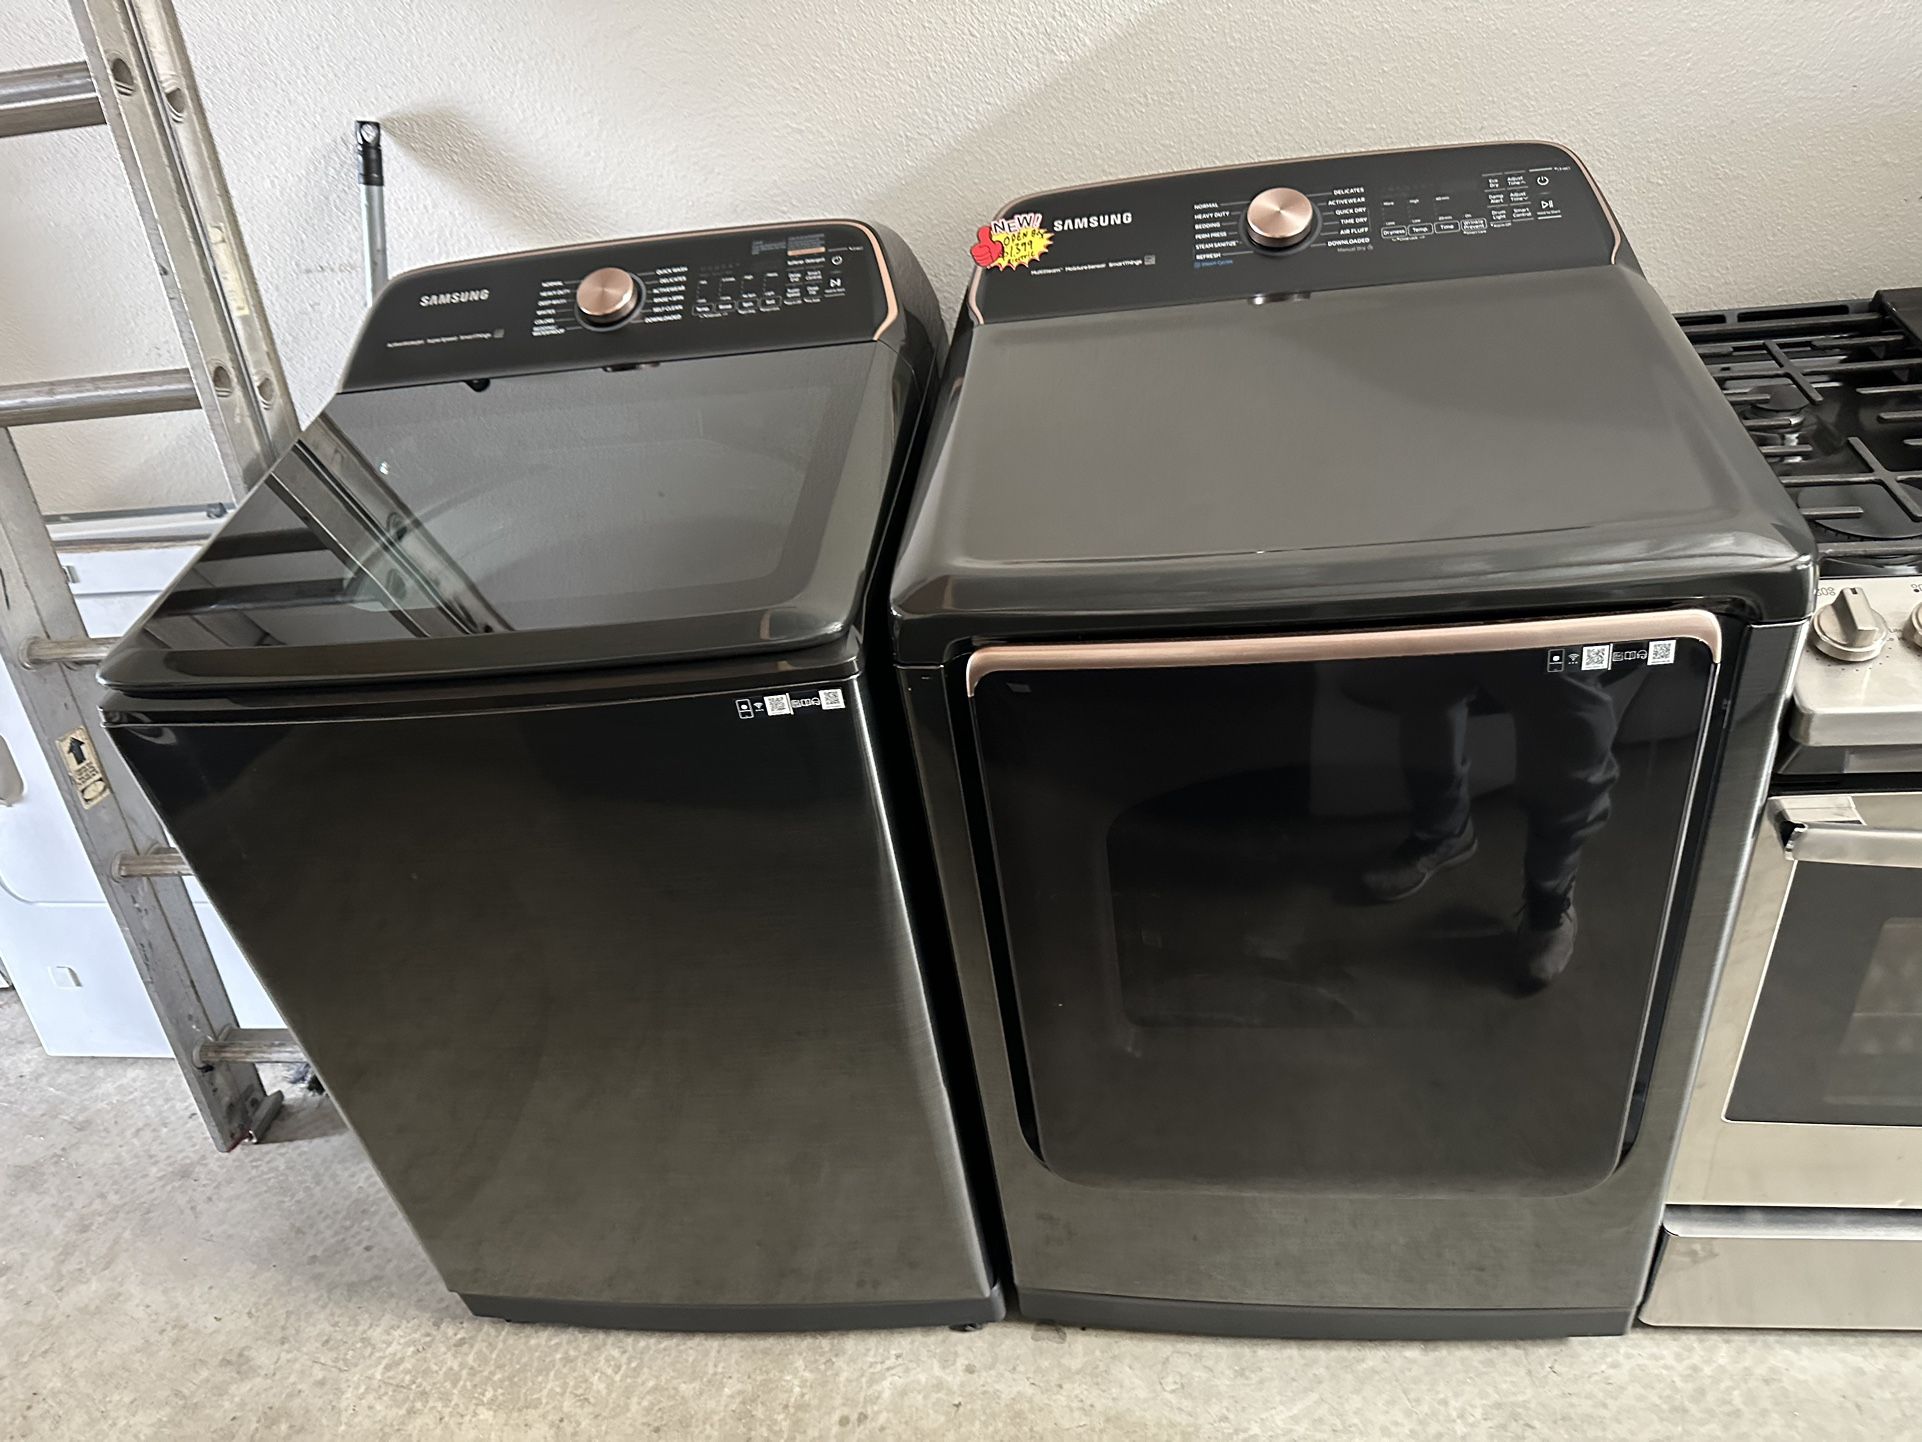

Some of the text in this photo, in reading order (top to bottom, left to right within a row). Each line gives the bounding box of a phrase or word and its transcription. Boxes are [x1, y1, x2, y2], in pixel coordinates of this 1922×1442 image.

[1193, 202, 1219, 210] NORMAL
[1053, 212, 1133, 232] SAMSUNG
[420, 288, 490, 307] SAMSUNG
